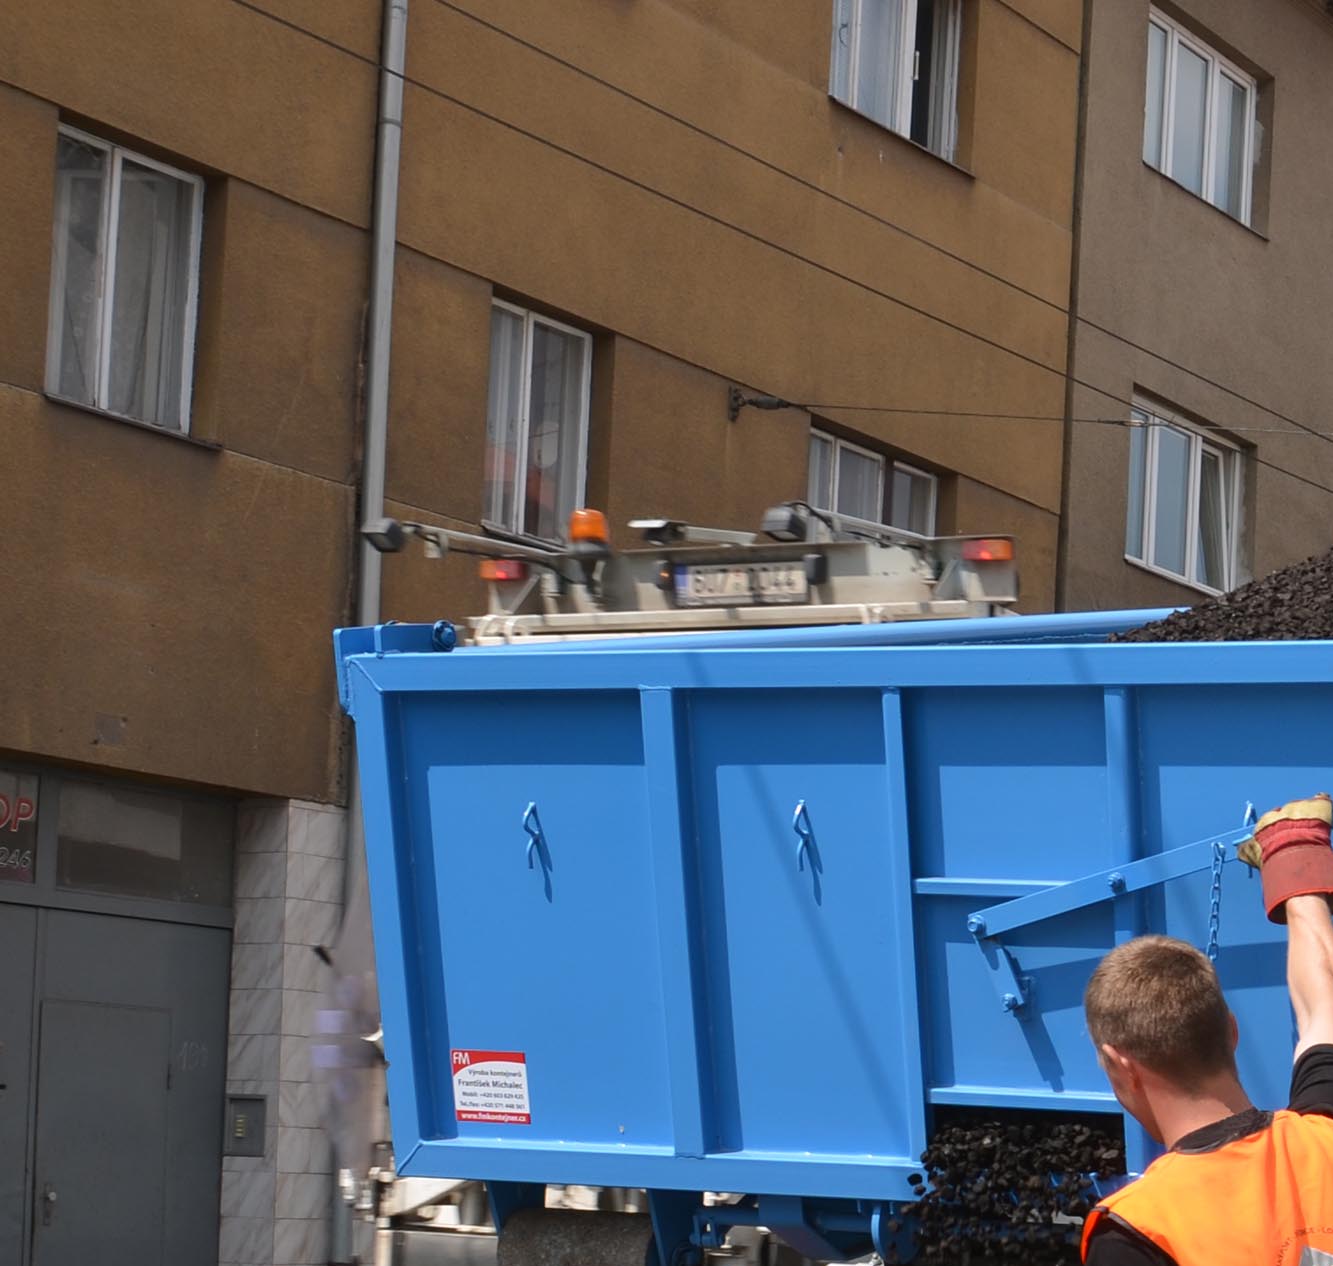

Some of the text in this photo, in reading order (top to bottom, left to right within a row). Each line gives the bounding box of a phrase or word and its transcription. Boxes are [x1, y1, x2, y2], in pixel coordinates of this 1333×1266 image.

[453, 1052, 470, 1065] FM
[458, 1079, 524, 1089] František Michalec
